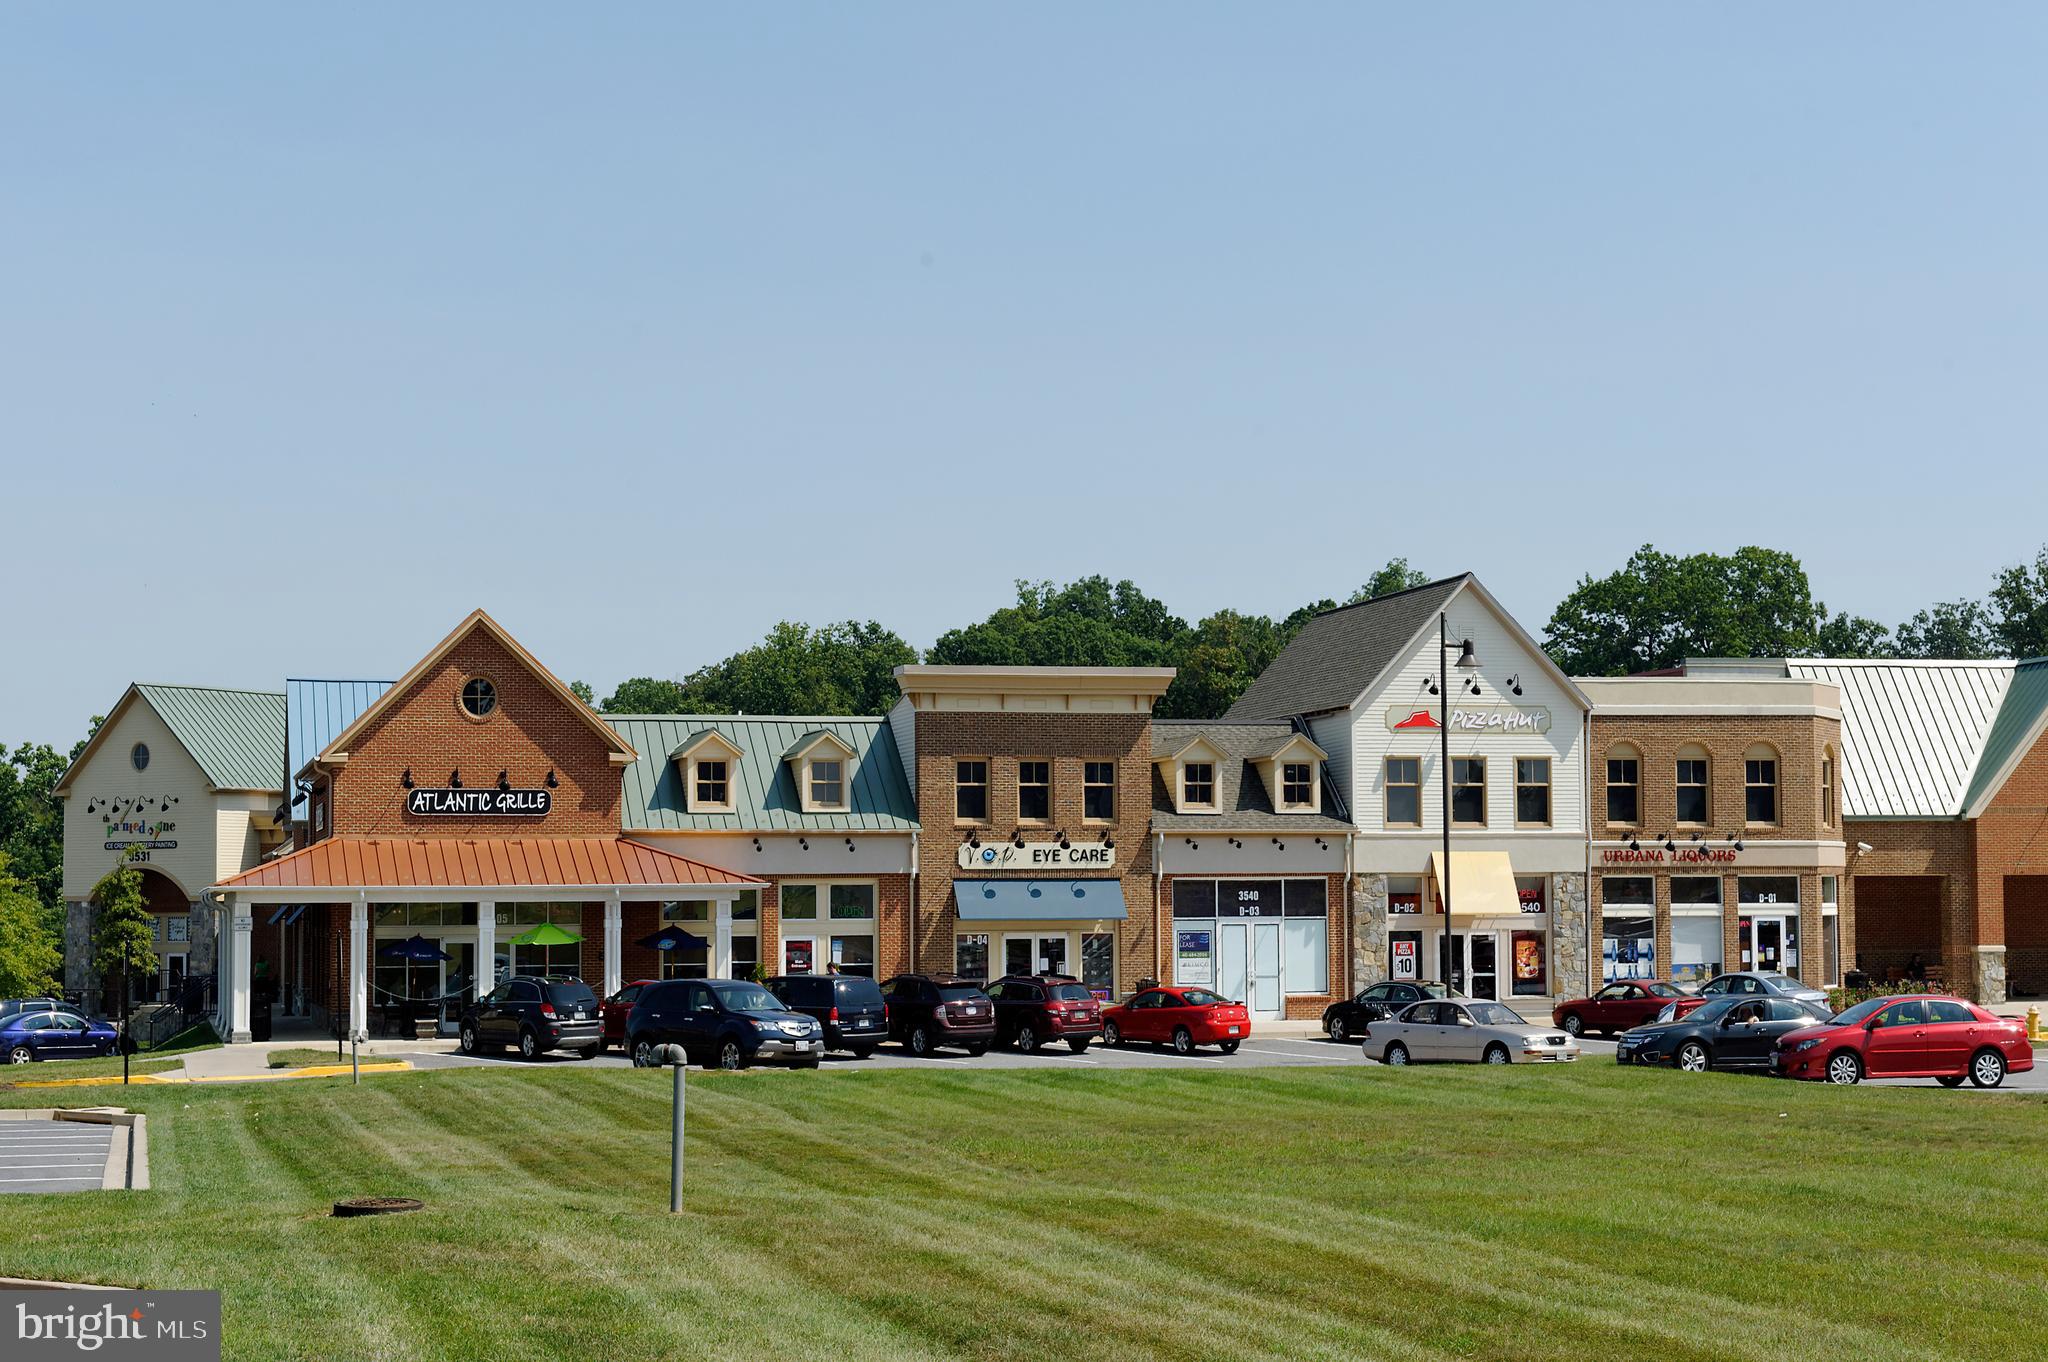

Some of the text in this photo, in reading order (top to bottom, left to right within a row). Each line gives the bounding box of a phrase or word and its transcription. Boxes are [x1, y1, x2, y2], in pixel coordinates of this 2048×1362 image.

[412, 791, 546, 813] ATLANTIC GRILLE
[1033, 849, 1062, 862] EYE
[1069, 849, 1109, 862] CARE
[1604, 850, 1736, 863] URBANA LIQUORS
[1238, 891, 1259, 901] 3540
[1759, 893, 1777, 903] D-01
[1240, 906, 1260, 916] D-03
[1395, 903, 1415, 913] D-02
[1521, 902, 1540, 912] 540
[967, 935, 988, 945] D-04
